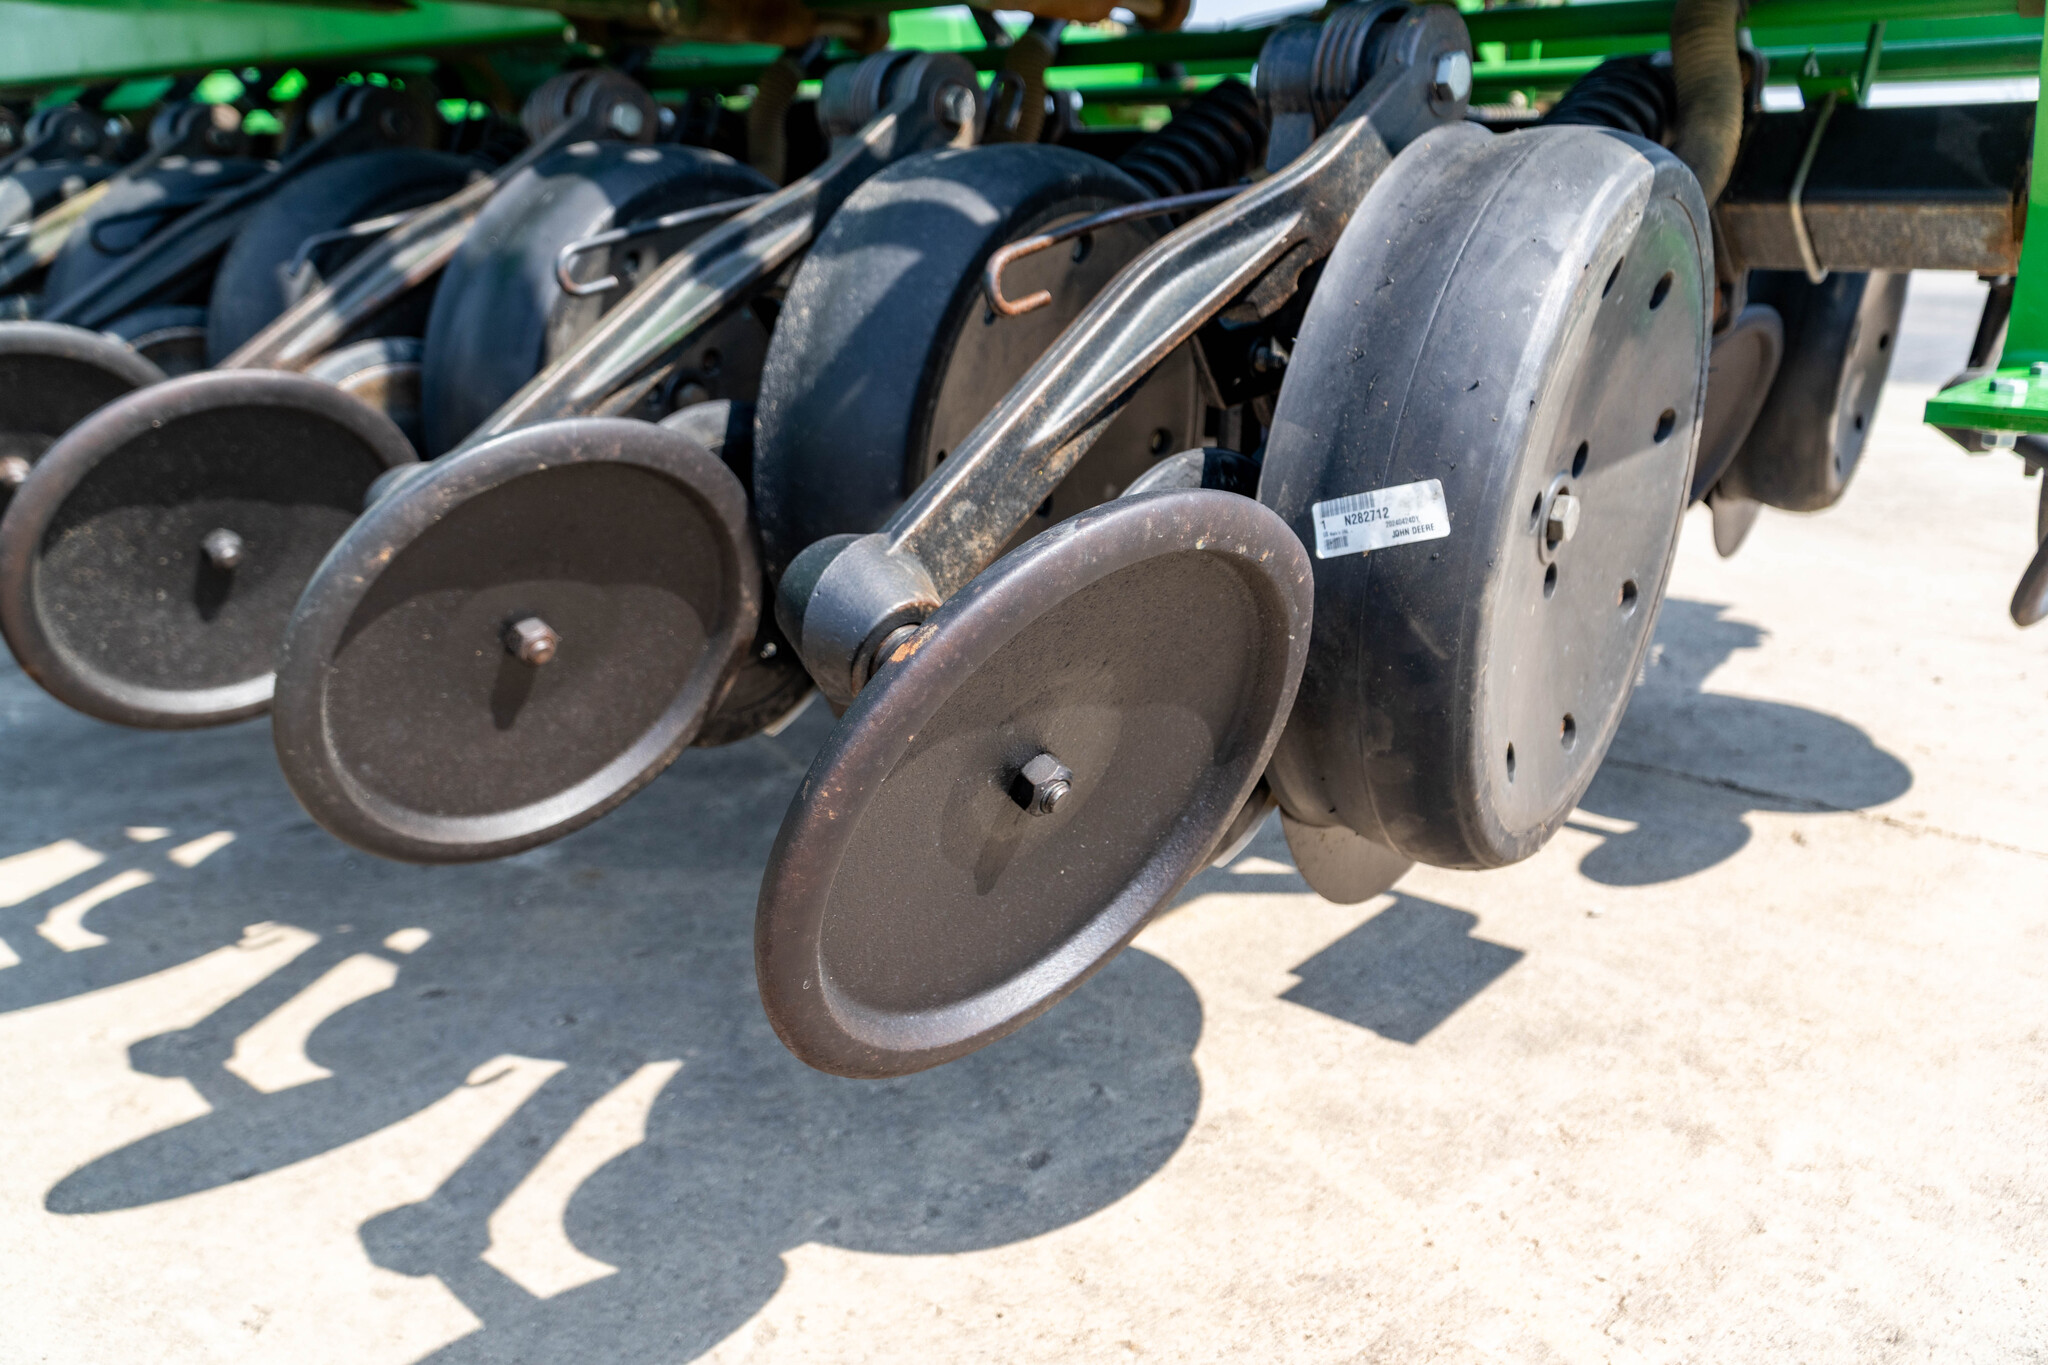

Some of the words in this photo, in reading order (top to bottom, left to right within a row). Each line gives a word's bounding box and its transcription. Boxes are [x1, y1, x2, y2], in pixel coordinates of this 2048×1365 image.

[1321, 520, 1326, 530] 1
[1345, 507, 1390, 526] N282712
[1392, 527, 1410, 538] JOHN
[1412, 523, 1435, 534] DEERE
